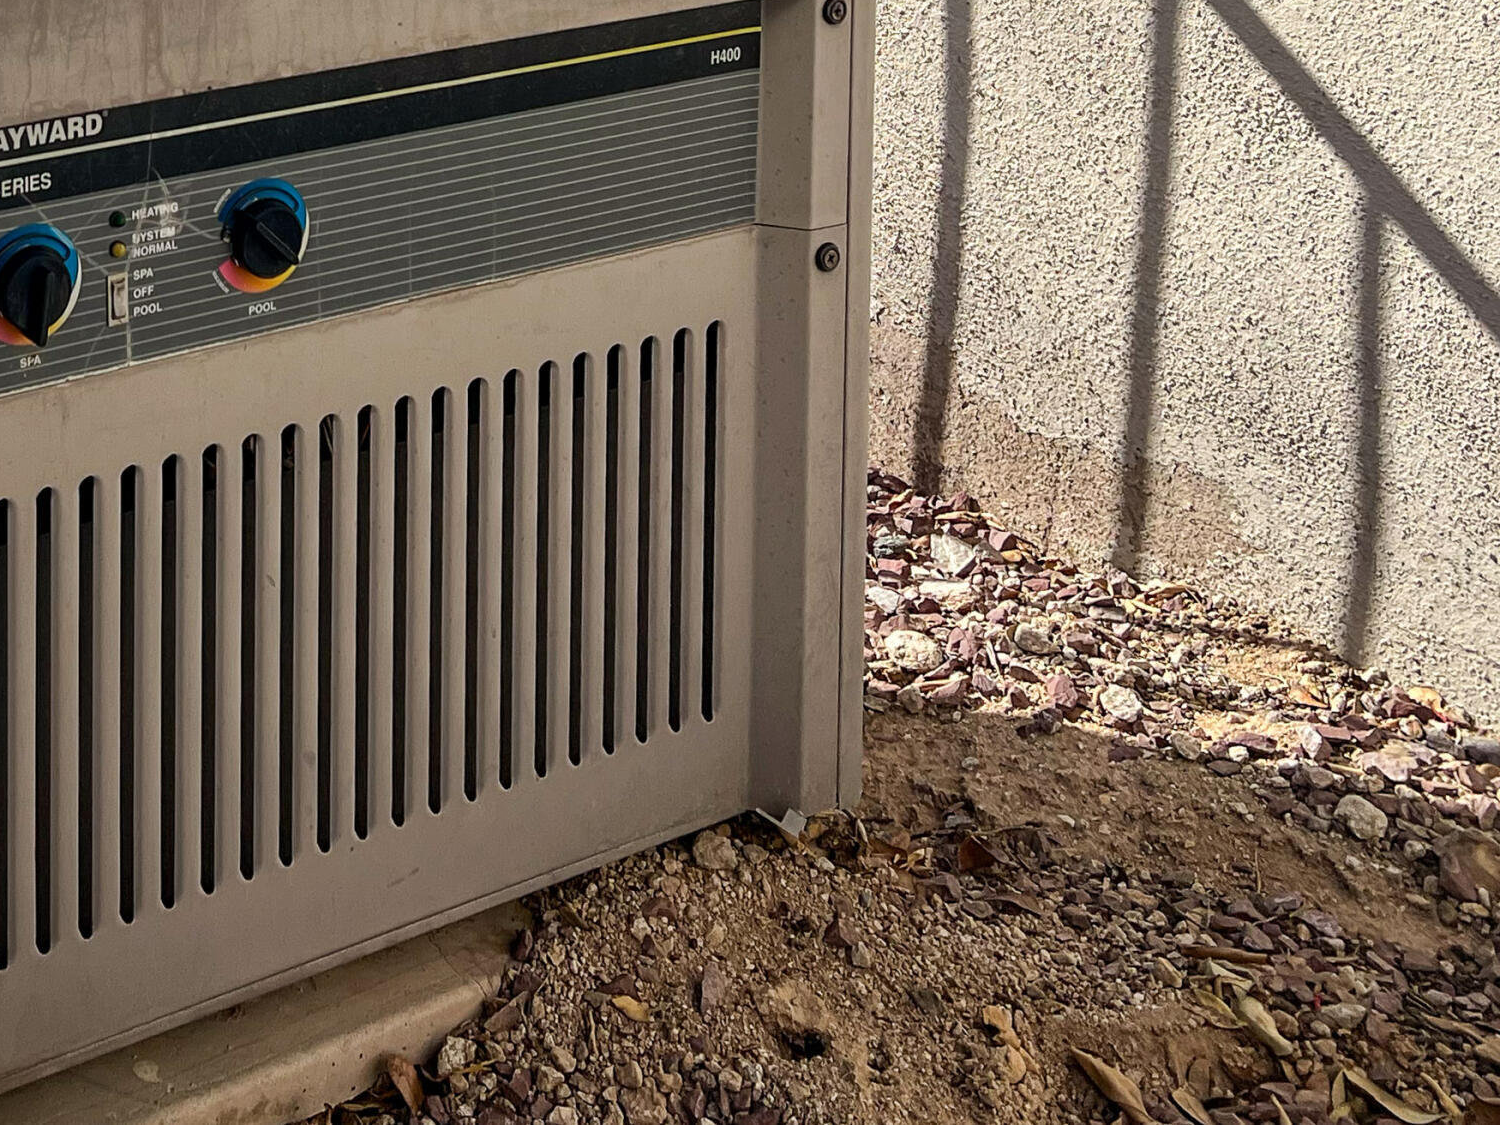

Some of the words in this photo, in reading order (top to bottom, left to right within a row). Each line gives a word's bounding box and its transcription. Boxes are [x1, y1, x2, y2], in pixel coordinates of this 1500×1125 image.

[710, 46, 741, 65] H400
[131, 202, 179, 220] HEATING
[132, 226, 176, 244] SYSTEM
[132, 240, 178, 258] NORMAL
[133, 267, 154, 281] SPA
[133, 285, 154, 298] OFF
[133, 303, 163, 317] POOL
[248, 301, 277, 315] POOL
[19, 355, 42, 368] SPA
